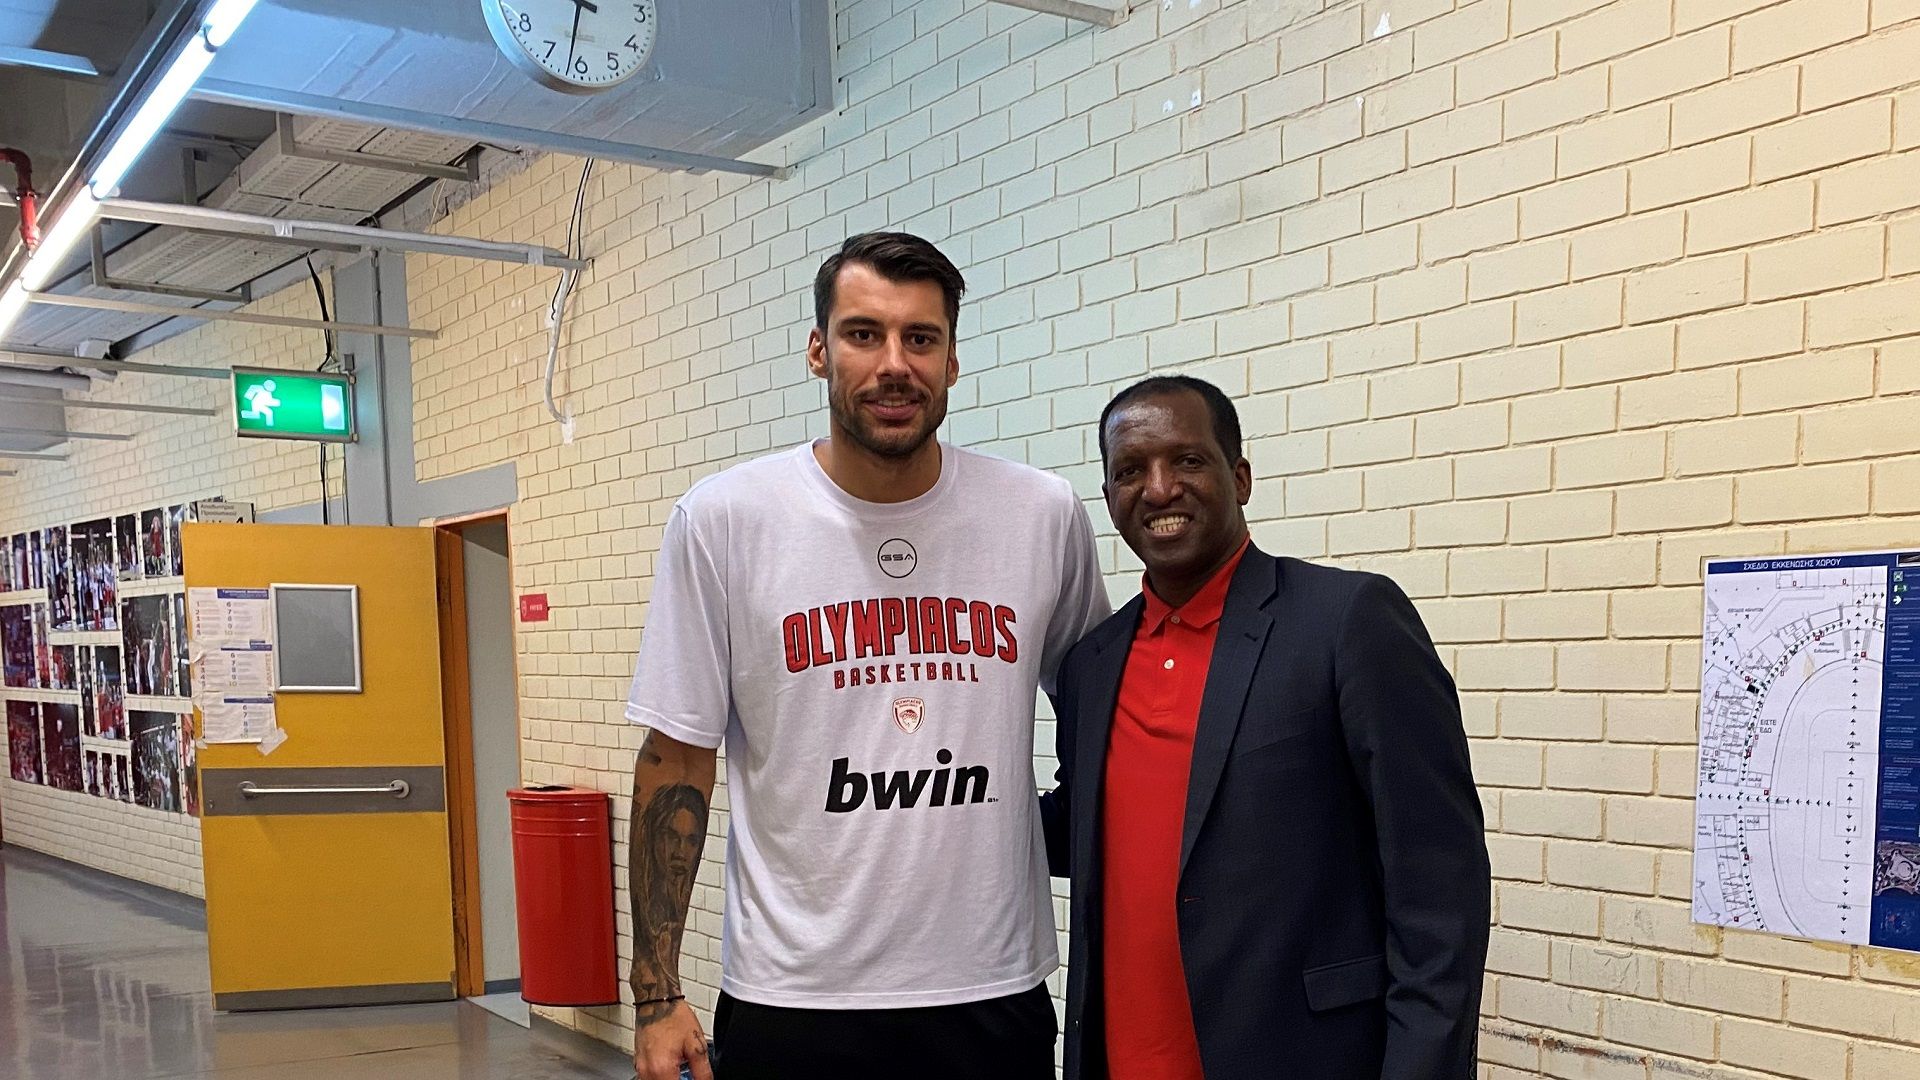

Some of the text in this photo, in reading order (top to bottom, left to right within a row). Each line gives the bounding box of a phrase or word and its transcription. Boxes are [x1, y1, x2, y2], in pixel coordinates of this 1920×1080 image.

[518, 13, 532, 32] 8
[632, 3, 646, 23] 3
[543, 40, 556, 59] 7
[624, 34, 639, 52] 4
[574, 56, 588, 74] 6
[606, 52, 619, 71] 5
[880, 553, 914, 561] GSA
[783, 596, 1018, 673] OLYMPIACOS
[834, 662, 979, 690] BASKETBALL
[824, 748, 990, 813] bwin
